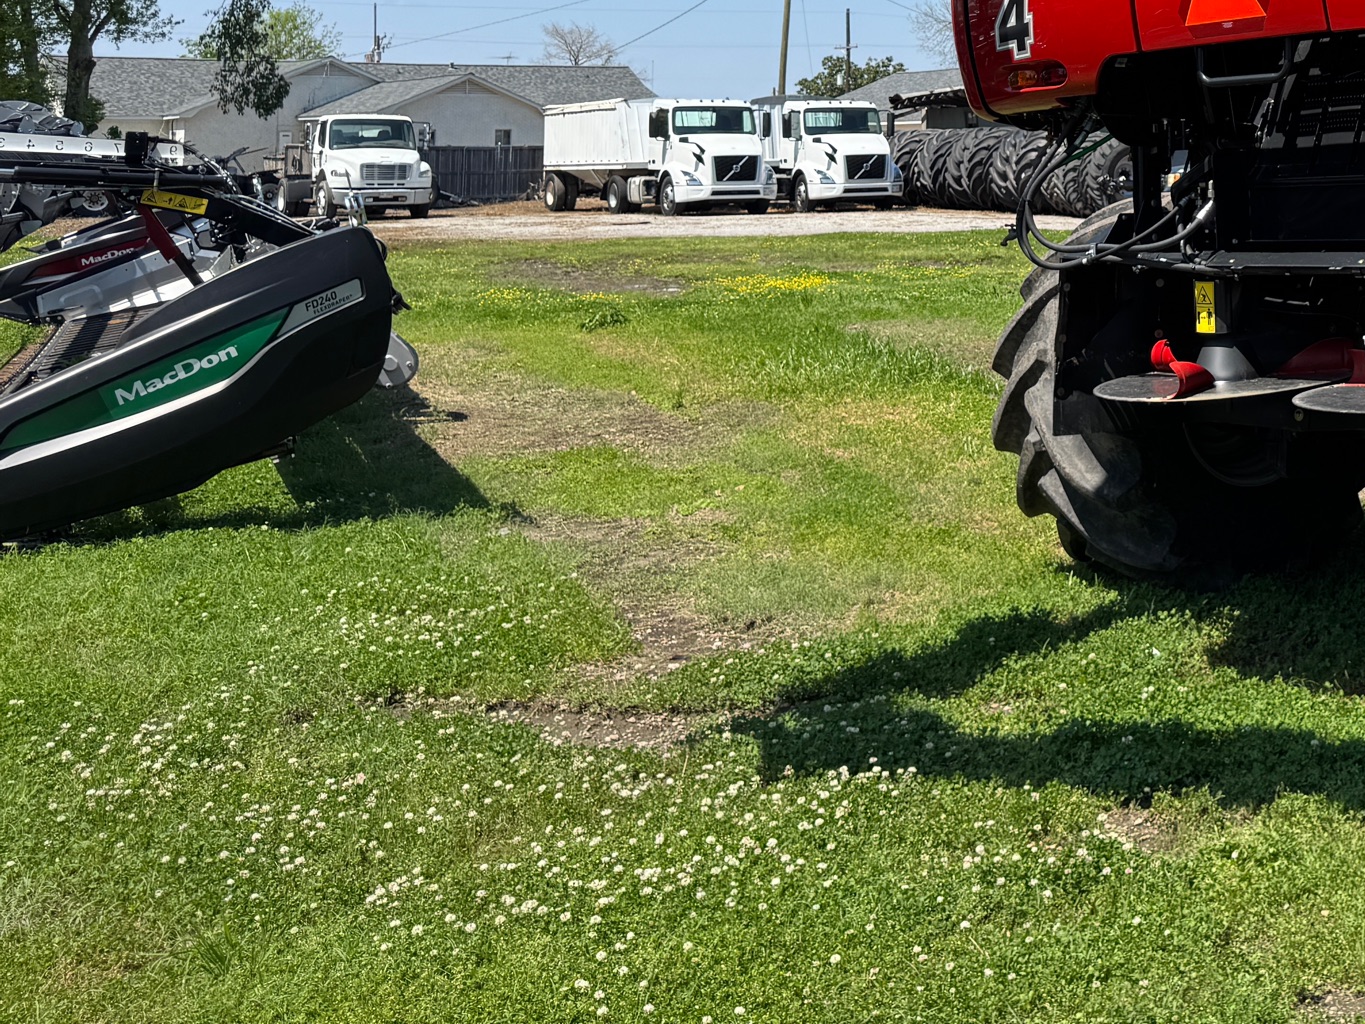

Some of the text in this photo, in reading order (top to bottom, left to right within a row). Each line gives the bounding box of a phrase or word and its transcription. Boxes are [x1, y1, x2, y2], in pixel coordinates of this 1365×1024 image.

[81, 247, 135, 266] MacDon
[305, 290, 338, 312] FD240
[114, 345, 239, 406] MacDon
